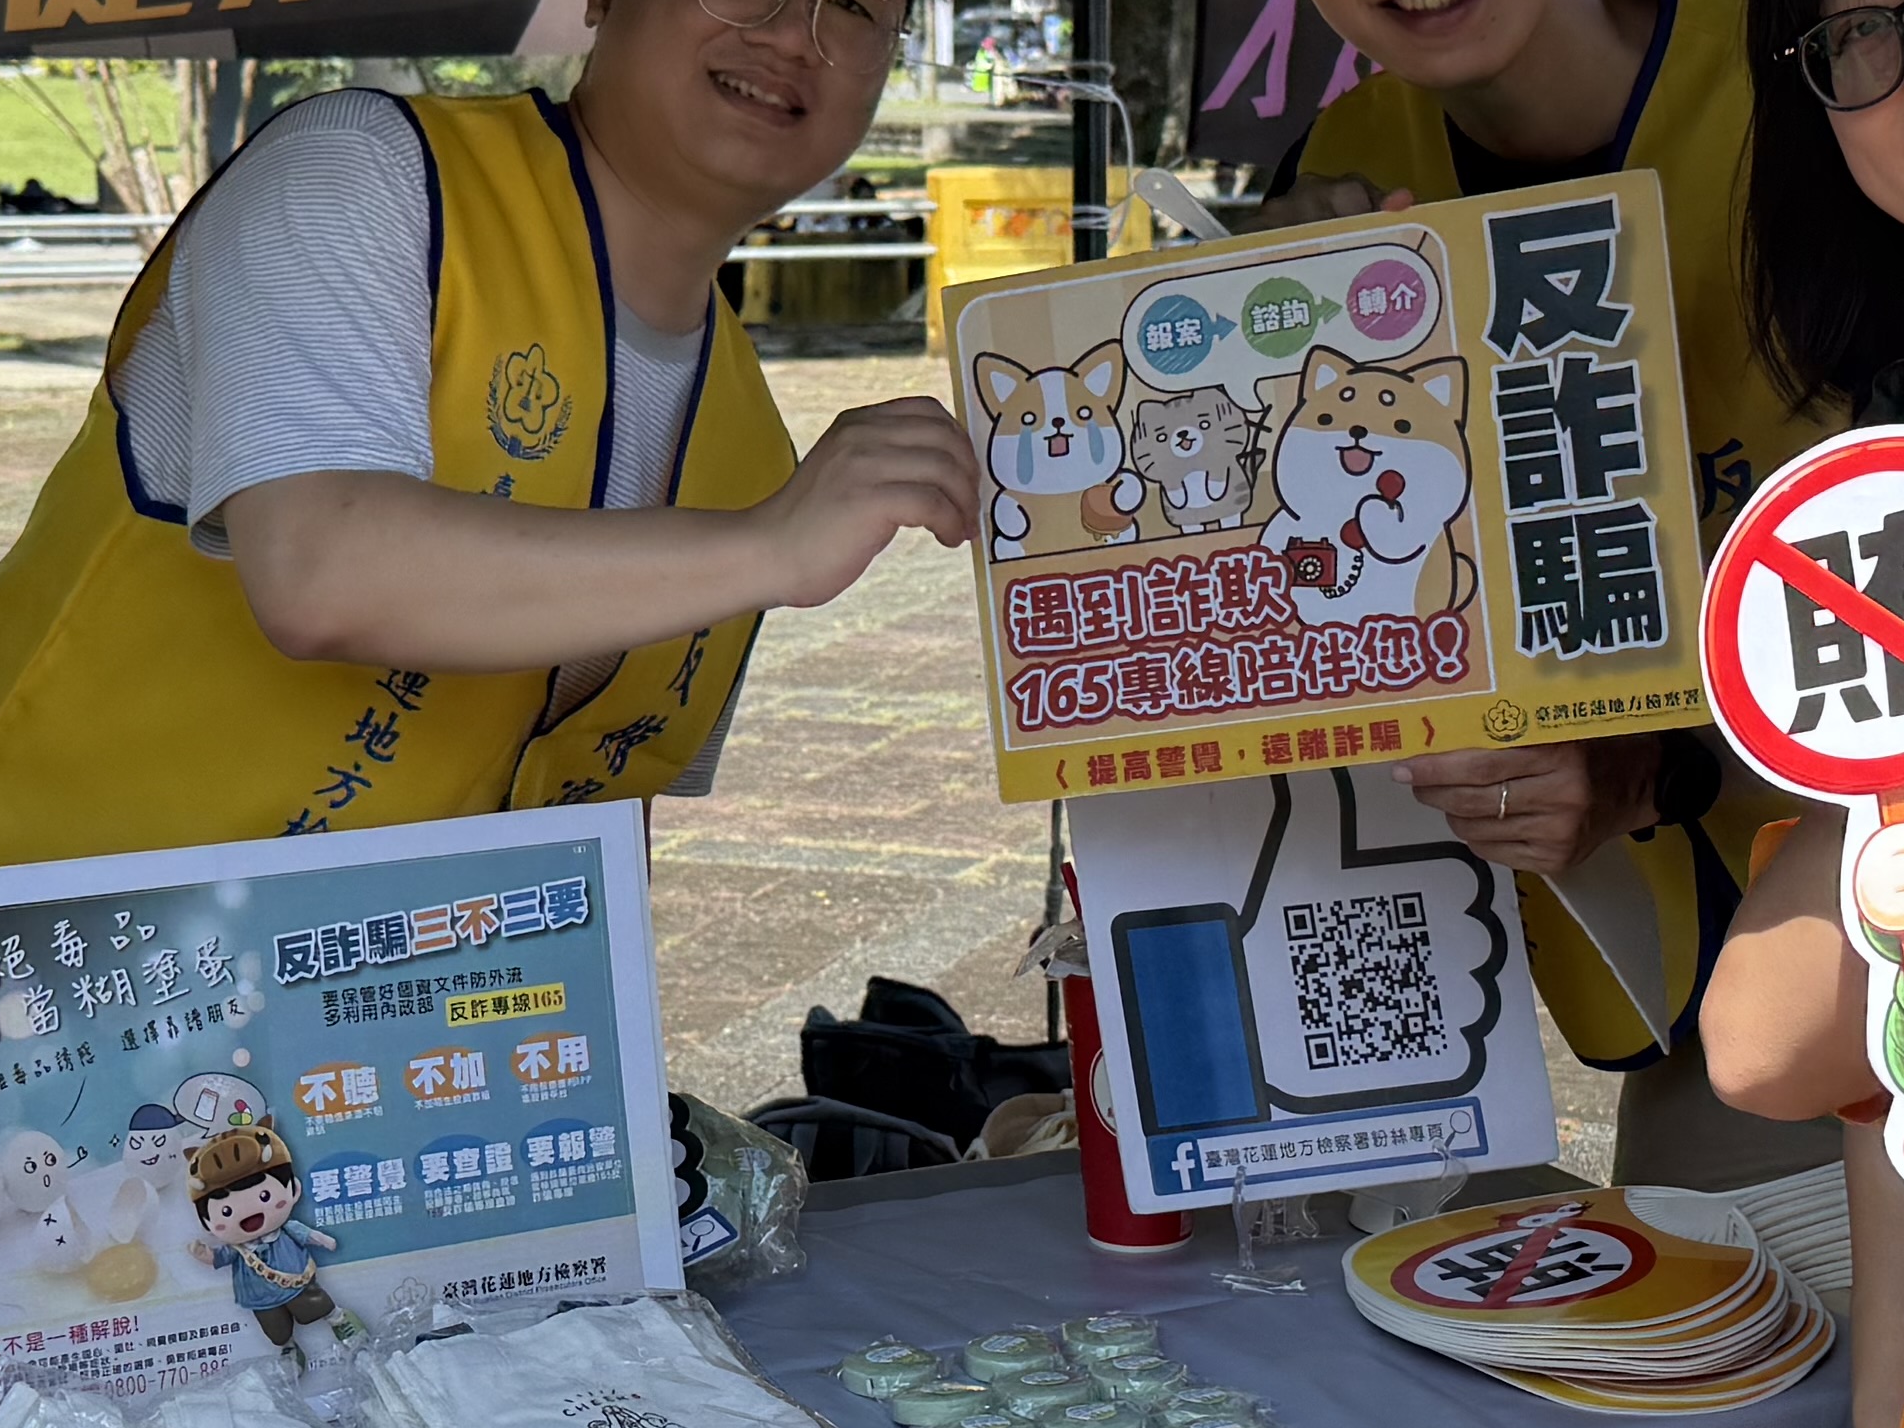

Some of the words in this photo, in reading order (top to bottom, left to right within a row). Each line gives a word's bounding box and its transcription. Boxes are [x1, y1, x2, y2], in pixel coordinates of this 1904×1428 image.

[1145, 314, 1204, 352] 報案
[1251, 296, 1311, 333] 諮詢
[1356, 281, 1418, 317] 轉介
[1482, 193, 1669, 660] 反詐騙
[1007, 549, 1294, 655] 遇到詐欺
[273, 876, 589, 985] 反詐騙三不三要
[300, 1066, 380, 1111] 不聽
[409, 1052, 487, 1095] 不加
[516, 1035, 590, 1080] 不用
[309, 1157, 408, 1203] 要警覺
[419, 1141, 514, 1185] 要查證
[526, 1125, 616, 1168] 要報警
[1204, 1122, 1444, 1169] 臺灣花蓮地方檢察署粉絲專頁
